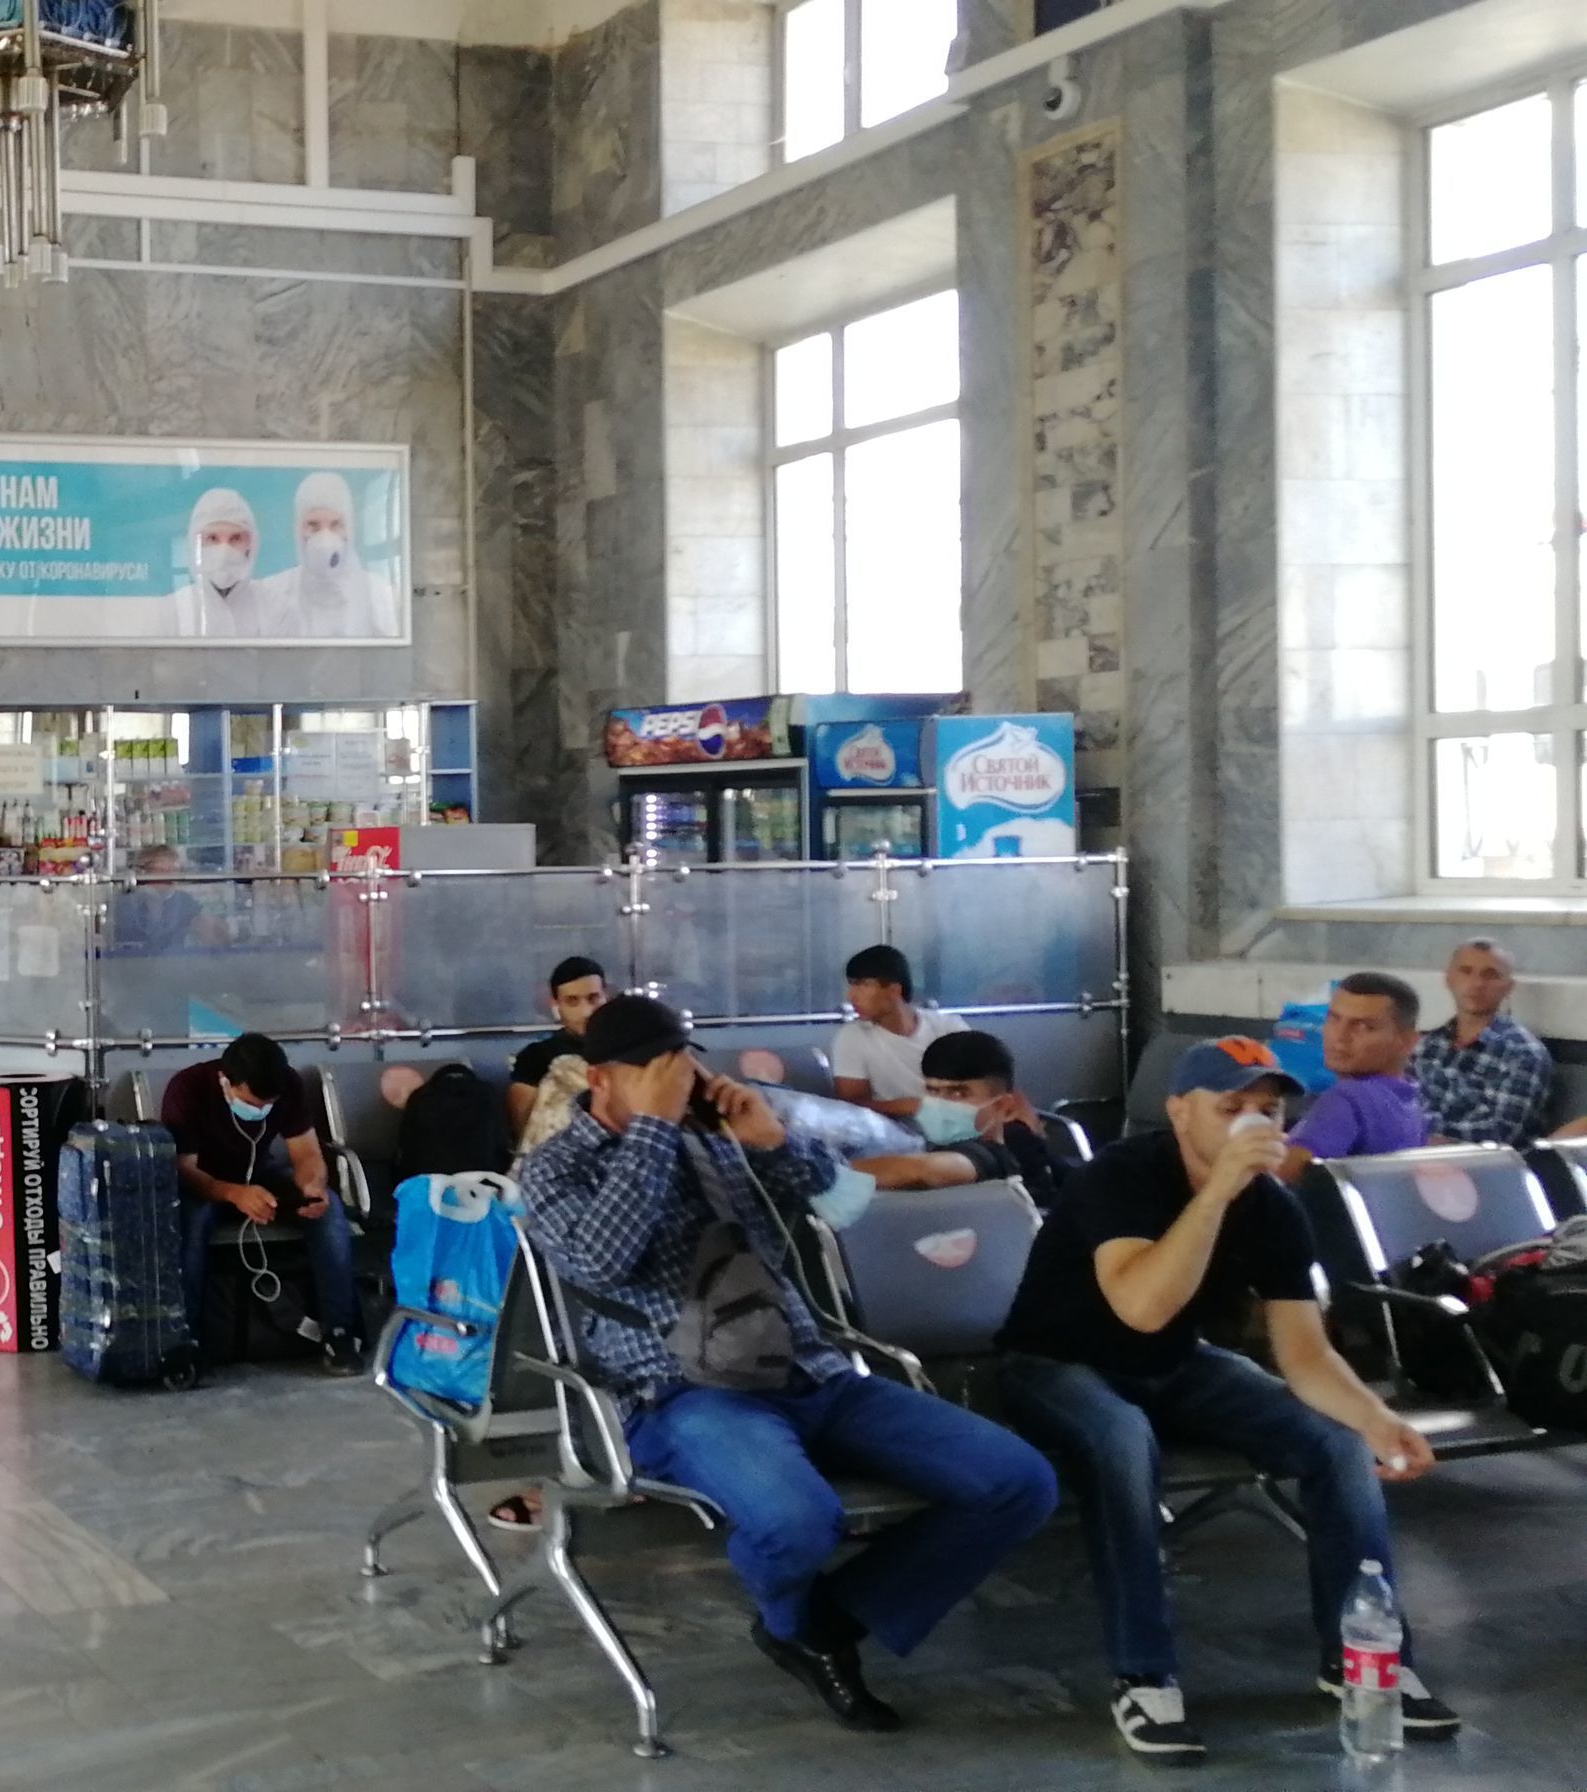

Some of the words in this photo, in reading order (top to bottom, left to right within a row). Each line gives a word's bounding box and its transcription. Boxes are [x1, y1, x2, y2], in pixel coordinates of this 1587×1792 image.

[0, 475, 59, 510] НАМ
[19, 561, 37, 579] ОТ
[40, 561, 150, 583] КОРОНАВИРУСА!
[641, 710, 701, 737] PEPSI
[24, 1173, 46, 1244] ОТХОДЫ
[28, 1246, 49, 1350] ПРАВИЛЬНО
